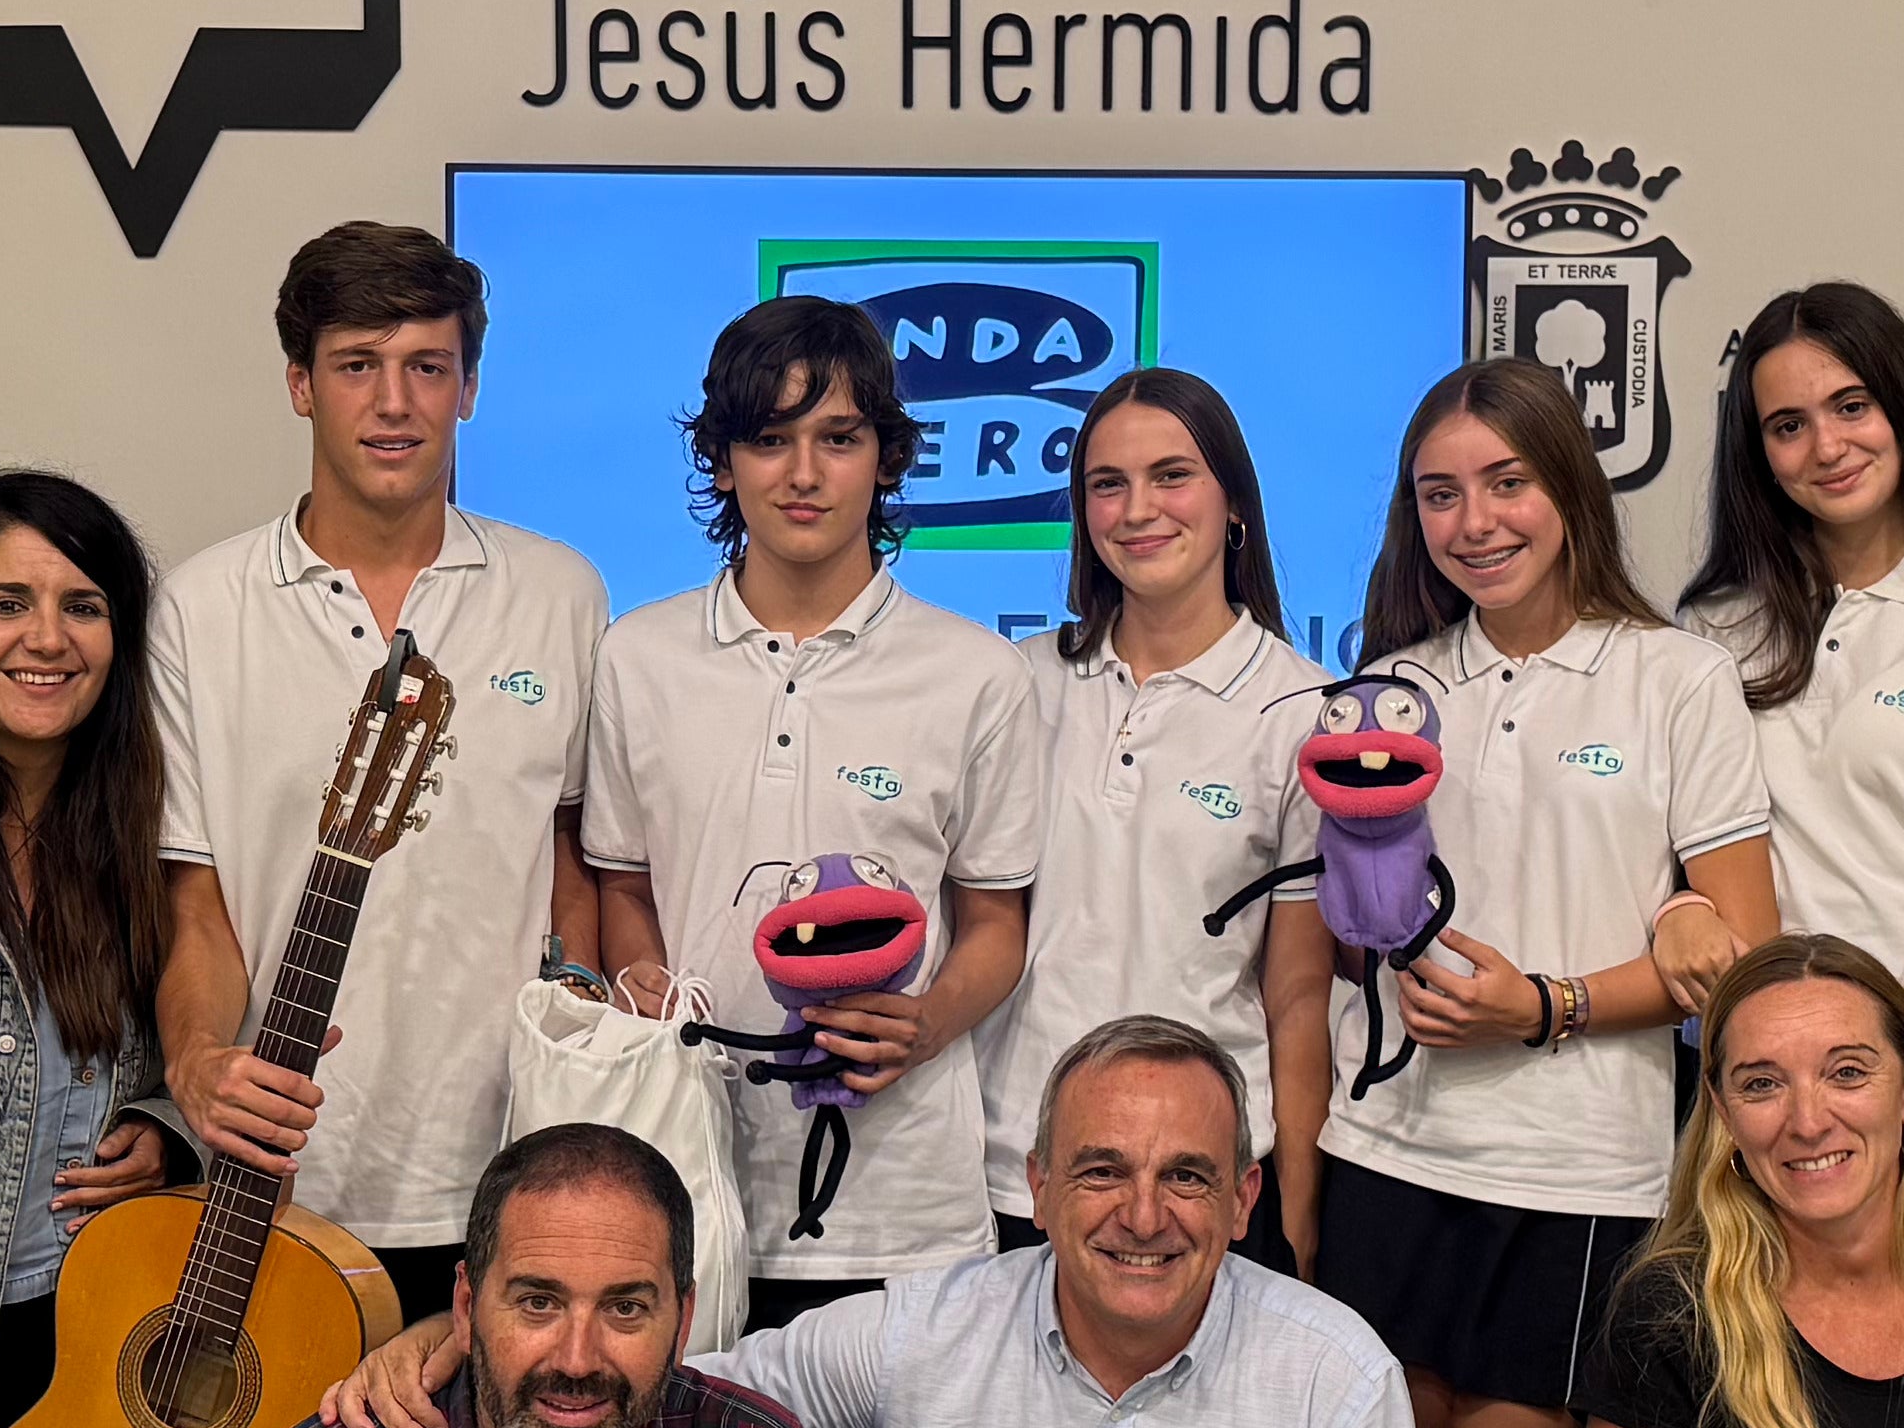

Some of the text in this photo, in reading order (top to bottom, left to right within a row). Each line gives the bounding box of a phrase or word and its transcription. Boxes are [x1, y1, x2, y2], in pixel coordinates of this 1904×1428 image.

[1527, 264, 1550, 279] ET
[892, 315, 1083, 365] NDA
[1492, 295, 1508, 352] MARIS
[1631, 318, 1648, 409] CUSTODIA
[904, 419, 1077, 479] ERO
[489, 673, 544, 697] festa
[1558, 749, 1619, 769] festa
[837, 766, 901, 793] festa
[1179, 780, 1240, 814] festa
